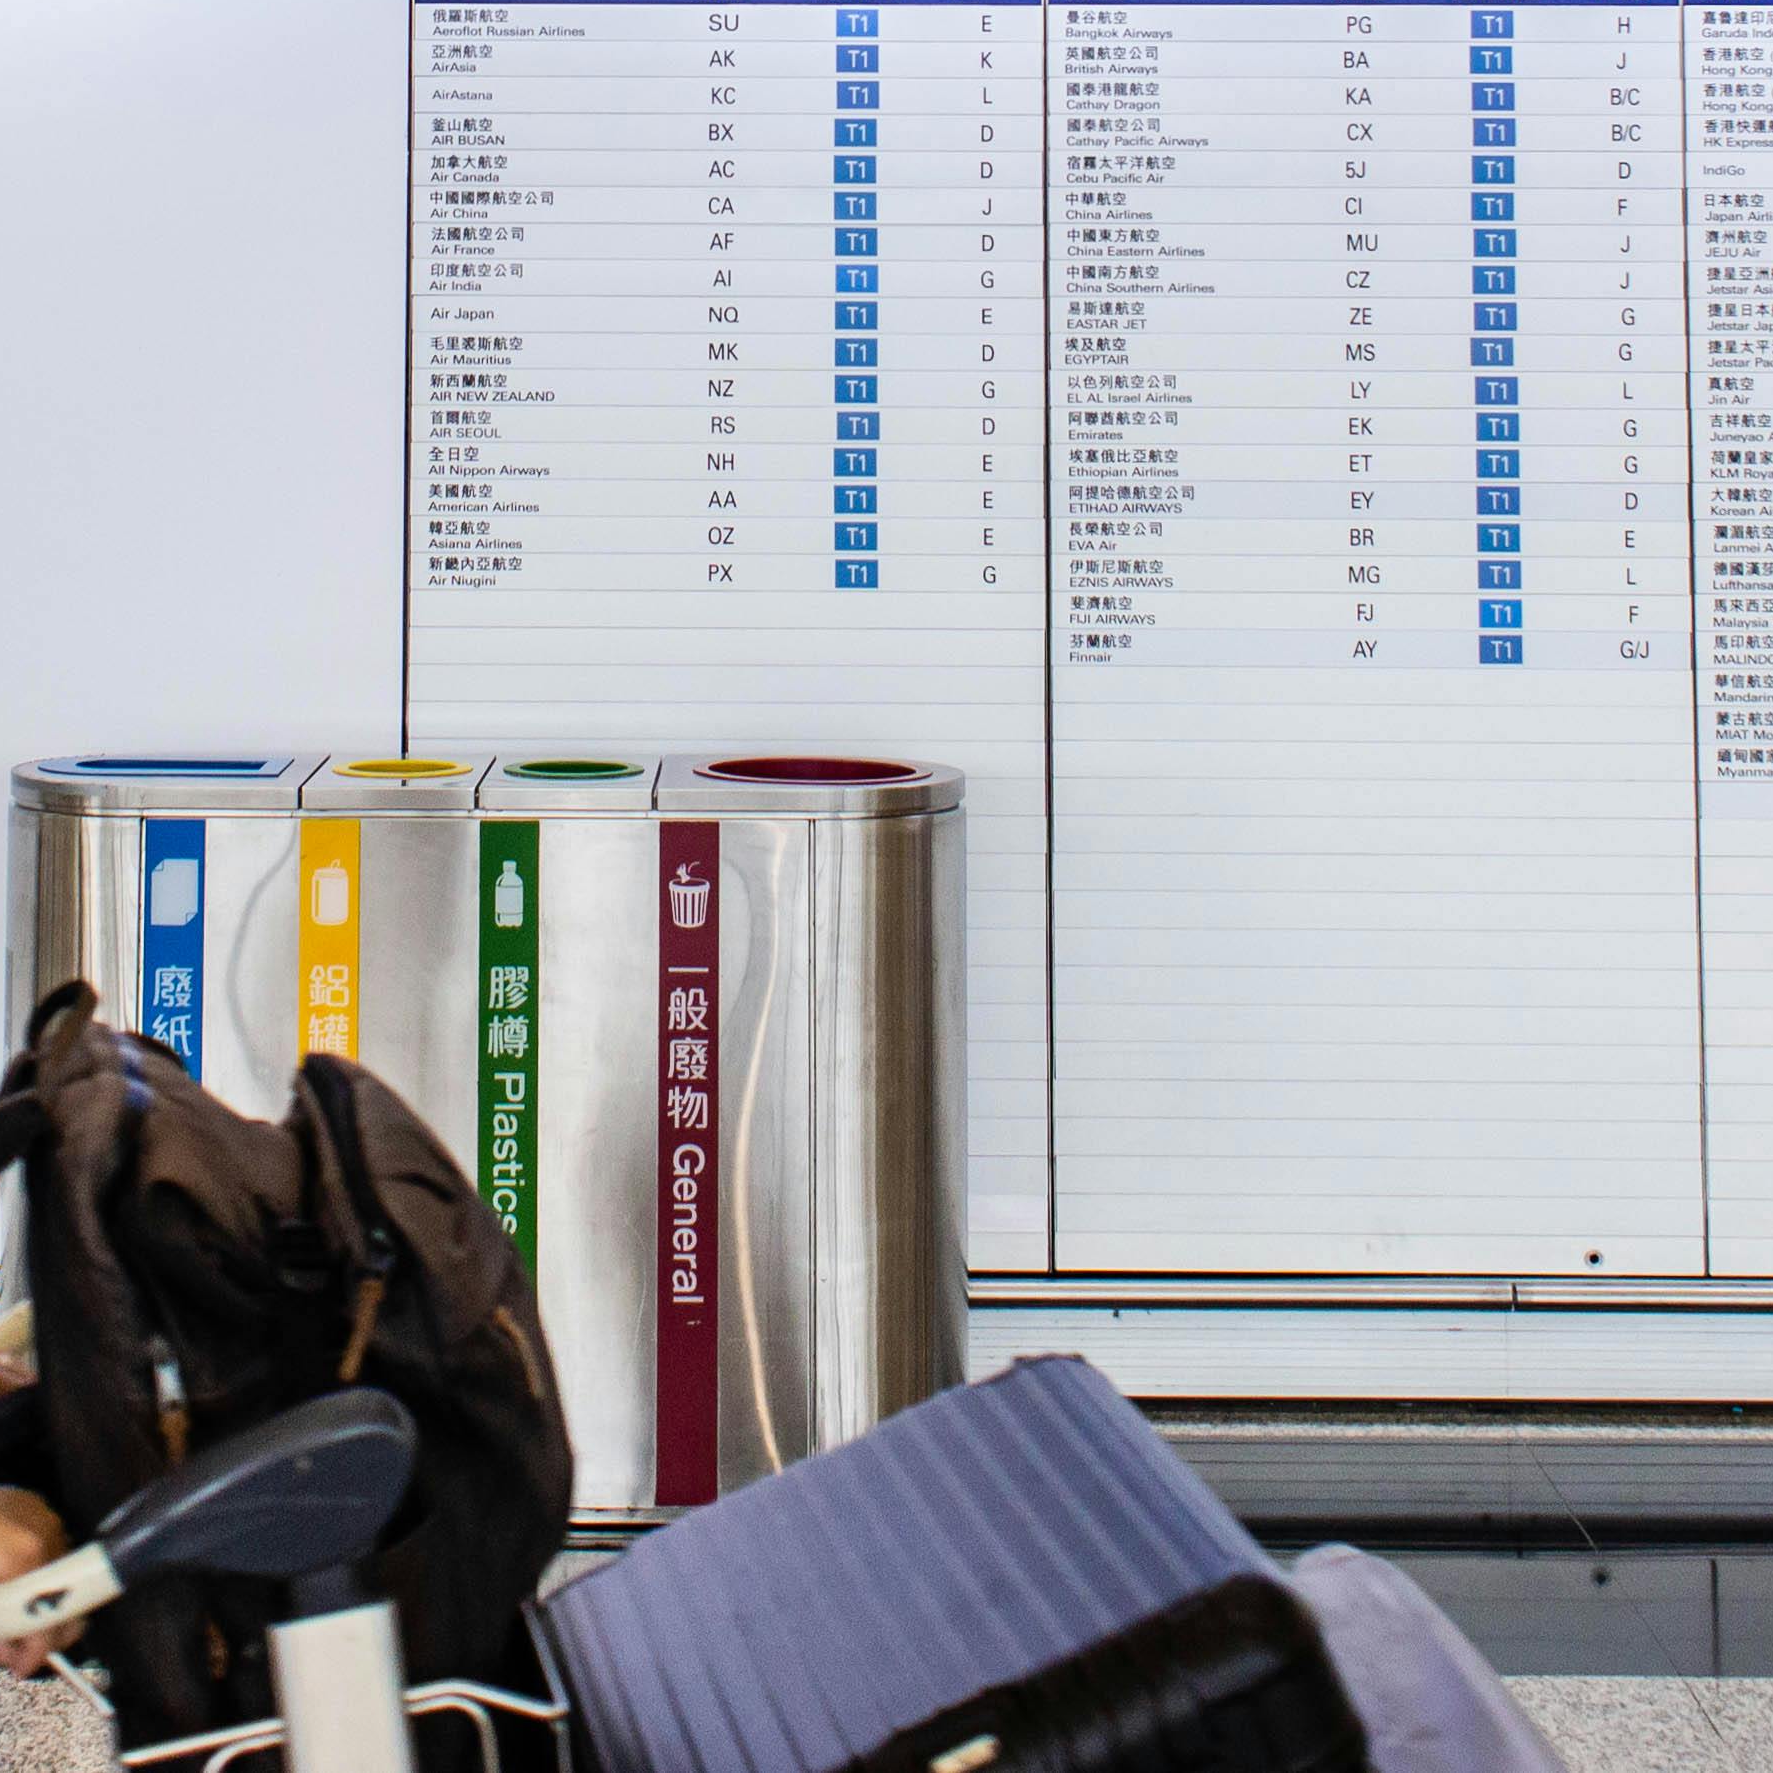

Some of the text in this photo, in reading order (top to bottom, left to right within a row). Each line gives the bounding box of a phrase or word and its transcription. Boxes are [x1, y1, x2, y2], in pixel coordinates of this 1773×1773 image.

[432, 25, 586, 37] Aeroflot Russian Airlines
[708, 13, 739, 32] SU
[846, 13, 869, 33] T1
[981, 14, 992, 33] E
[1346, 87, 1372, 105] KA
[1482, 87, 1505, 106] T1
[1610, 87, 1641, 106] B/C
[1066, 99, 1161, 112] Cathay Dragon
[1702, 164, 1746, 177] IndiGo
[1709, 431, 1765, 444] Juneyao
[428, 575, 496, 589] Air Niugini
[1069, 651, 1111, 663] Finnair
[1352, 640, 1378, 659] AY
[1490, 640, 1512, 660] T1
[1619, 640, 1650, 660] G/J
[153, 965, 194, 1057] 廢紙
[487, 965, 530, 1059] 膠樽
[667, 966, 709, 1304] 一般廢物 General
